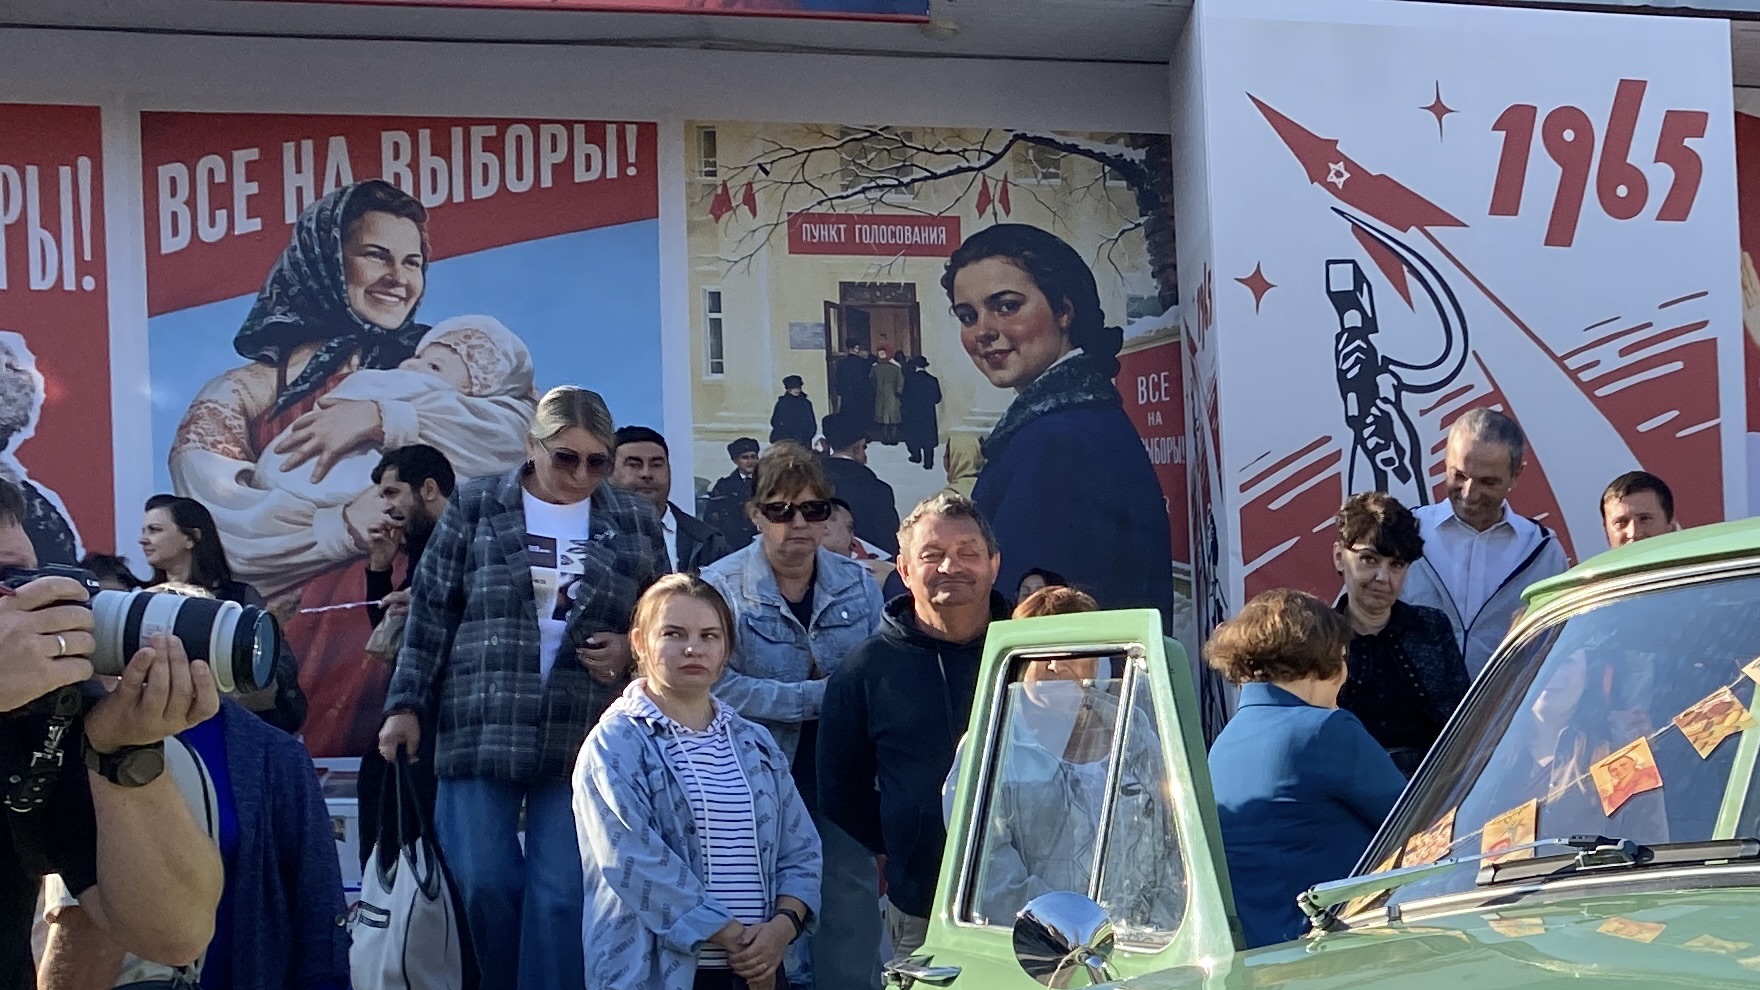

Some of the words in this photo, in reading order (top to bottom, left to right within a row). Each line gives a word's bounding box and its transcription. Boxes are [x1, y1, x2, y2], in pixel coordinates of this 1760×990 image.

[1488, 79, 1710, 248] 1965
[157, 148, 262, 255] ВСЕ
[282, 135, 354, 224] НА
[381, 123, 639, 207] ВЫБОРЫ!
[802, 223, 847, 243] ПУНКТ
[855, 224, 946, 245] ГОЛОСОВАНИЯ
[1137, 371, 1171, 405] ВСЕ
[1147, 411, 1163, 427] НА
[1140, 436, 1186, 465] ЫБОРЫ!
